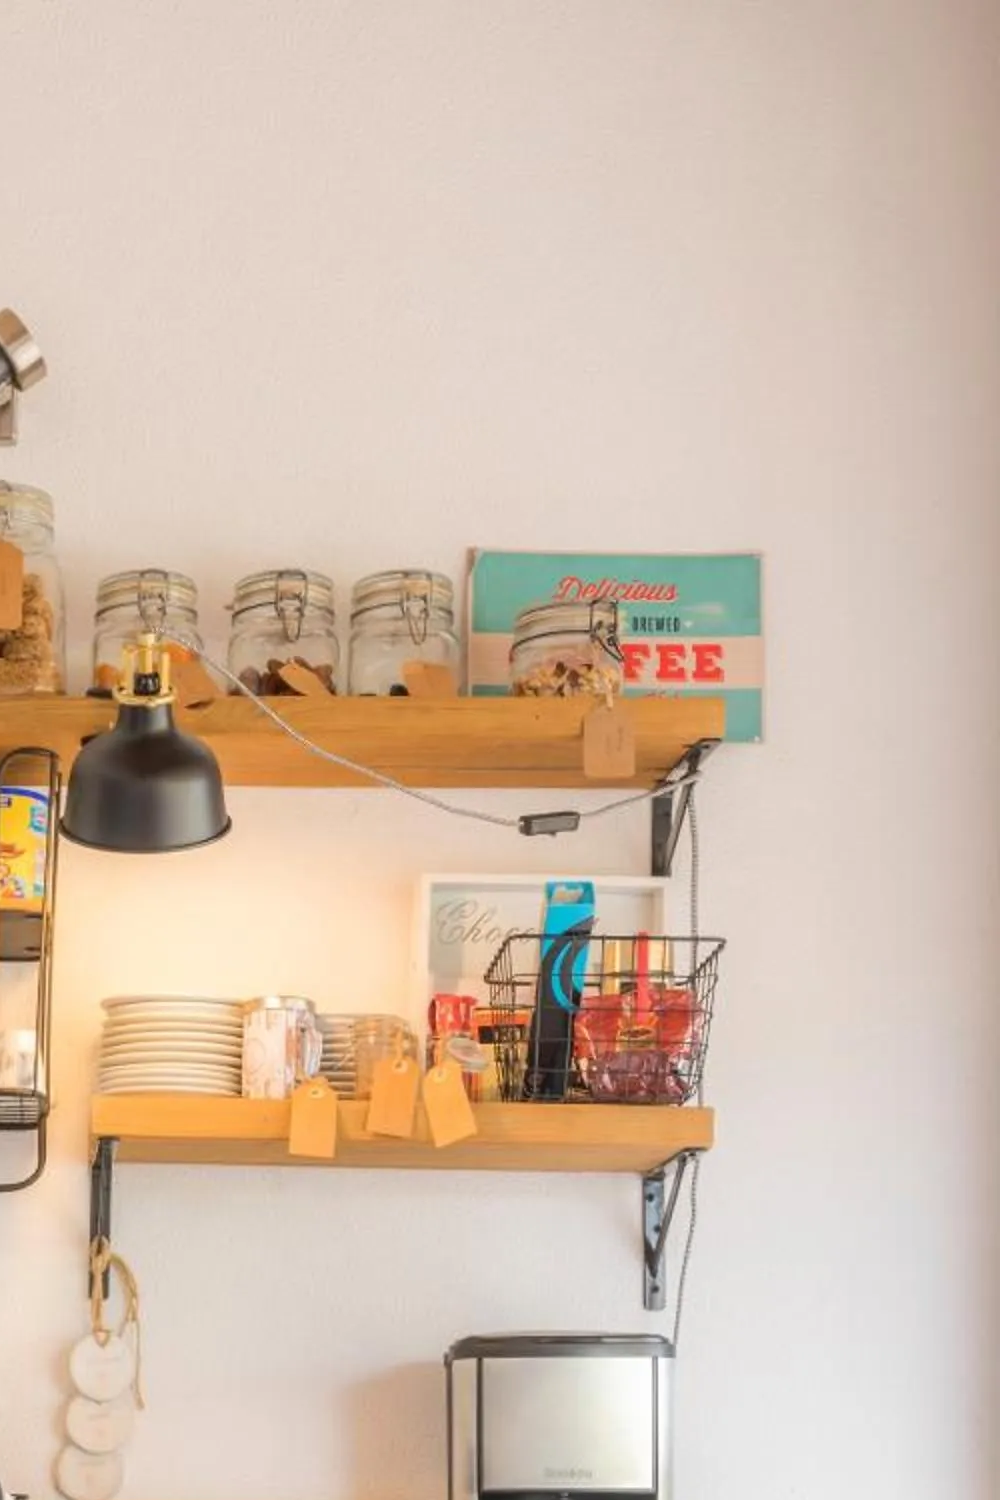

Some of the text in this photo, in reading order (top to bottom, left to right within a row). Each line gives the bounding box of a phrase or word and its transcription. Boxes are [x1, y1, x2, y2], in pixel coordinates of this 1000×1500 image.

[552, 576, 680, 602] Delicious
[631, 616, 681, 633] BREWED
[620, 643, 725, 683] FEE
[436, 897, 538, 945] Choco
